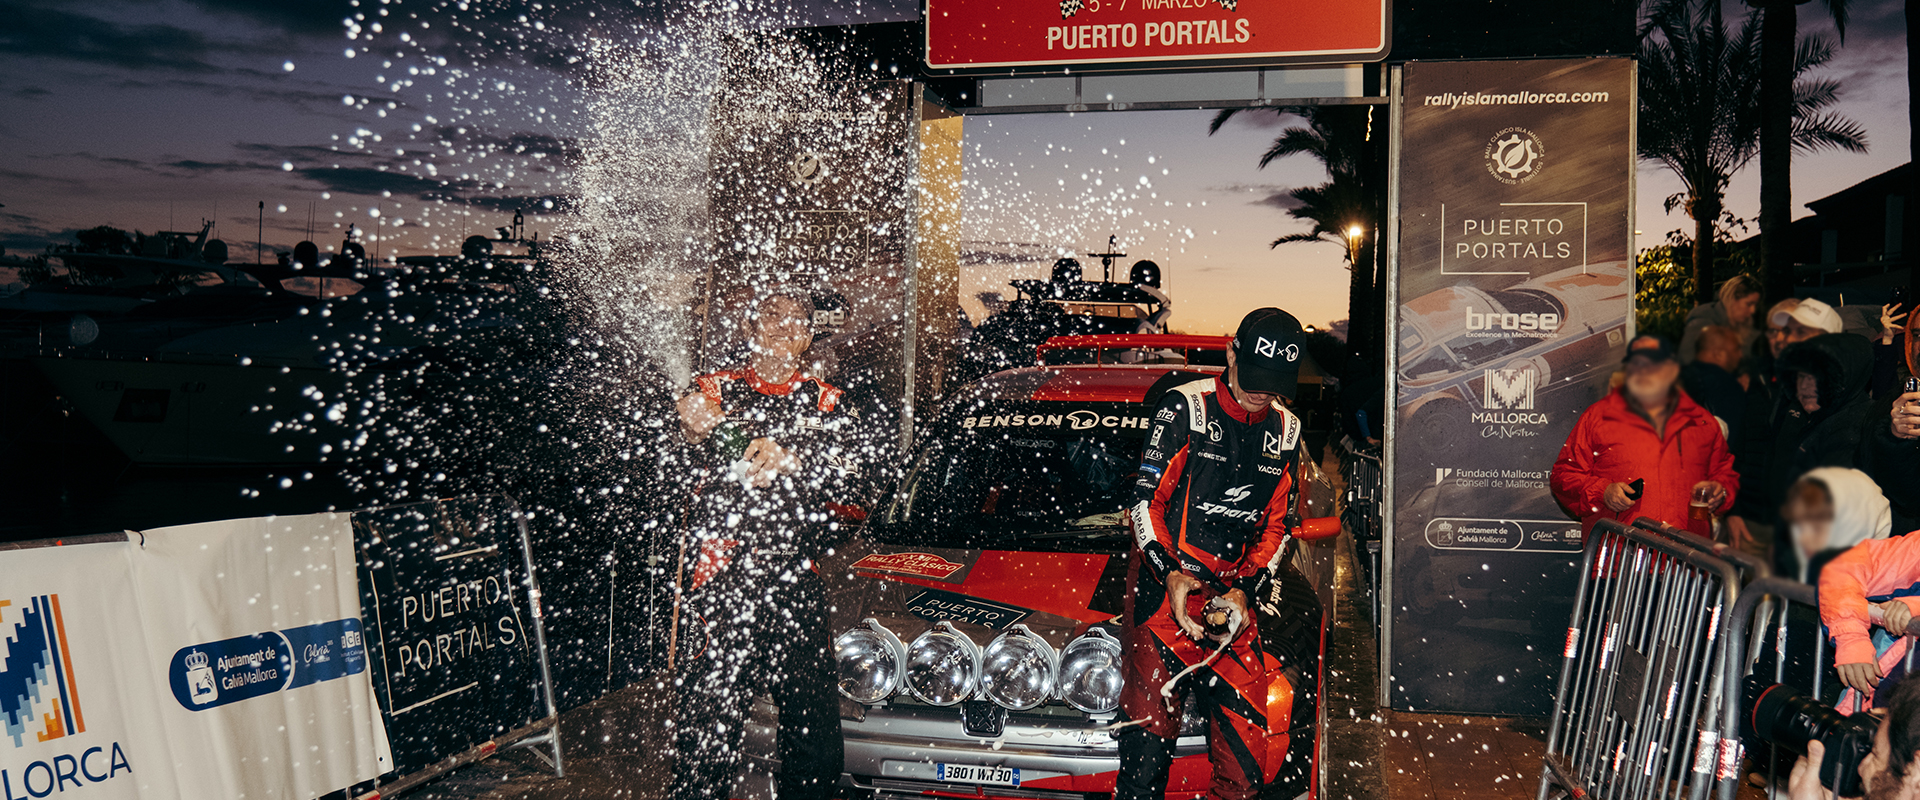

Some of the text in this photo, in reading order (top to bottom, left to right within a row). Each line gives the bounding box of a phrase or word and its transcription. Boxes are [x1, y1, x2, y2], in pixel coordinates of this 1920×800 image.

[1142, 0, 1207, 10] MARZO
[1047, 18, 1250, 50] PUERTO PORTALS
[1424, 90, 1610, 109] rallyislamallorca.com
[1464, 218, 1564, 235] PUERTO
[1456, 242, 1571, 258] PORTALS
[1466, 306, 1558, 330] brose
[962, 414, 1064, 429] BENSON
[1471, 412, 1549, 424] MALLORCA
[1257, 464, 1283, 476] YACCO
[1456, 468, 1499, 478] Fundació
[1501, 470, 1542, 479] Mallorca
[1456, 478, 1544, 489] Consell de Mallorca
[1457, 526, 1508, 535] Ajuntament de
[1478, 536, 1507, 544] Mallorca
[402, 575, 501, 628] PUERTO
[925, 599, 1000, 620] PUERTO
[398, 616, 516, 677] PORTALS
[217, 646, 276, 673] Ajuntament de
[244, 667, 278, 686] Mallorca
[945, 766, 974, 780] 3801
[995, 769, 1012, 782] 30
